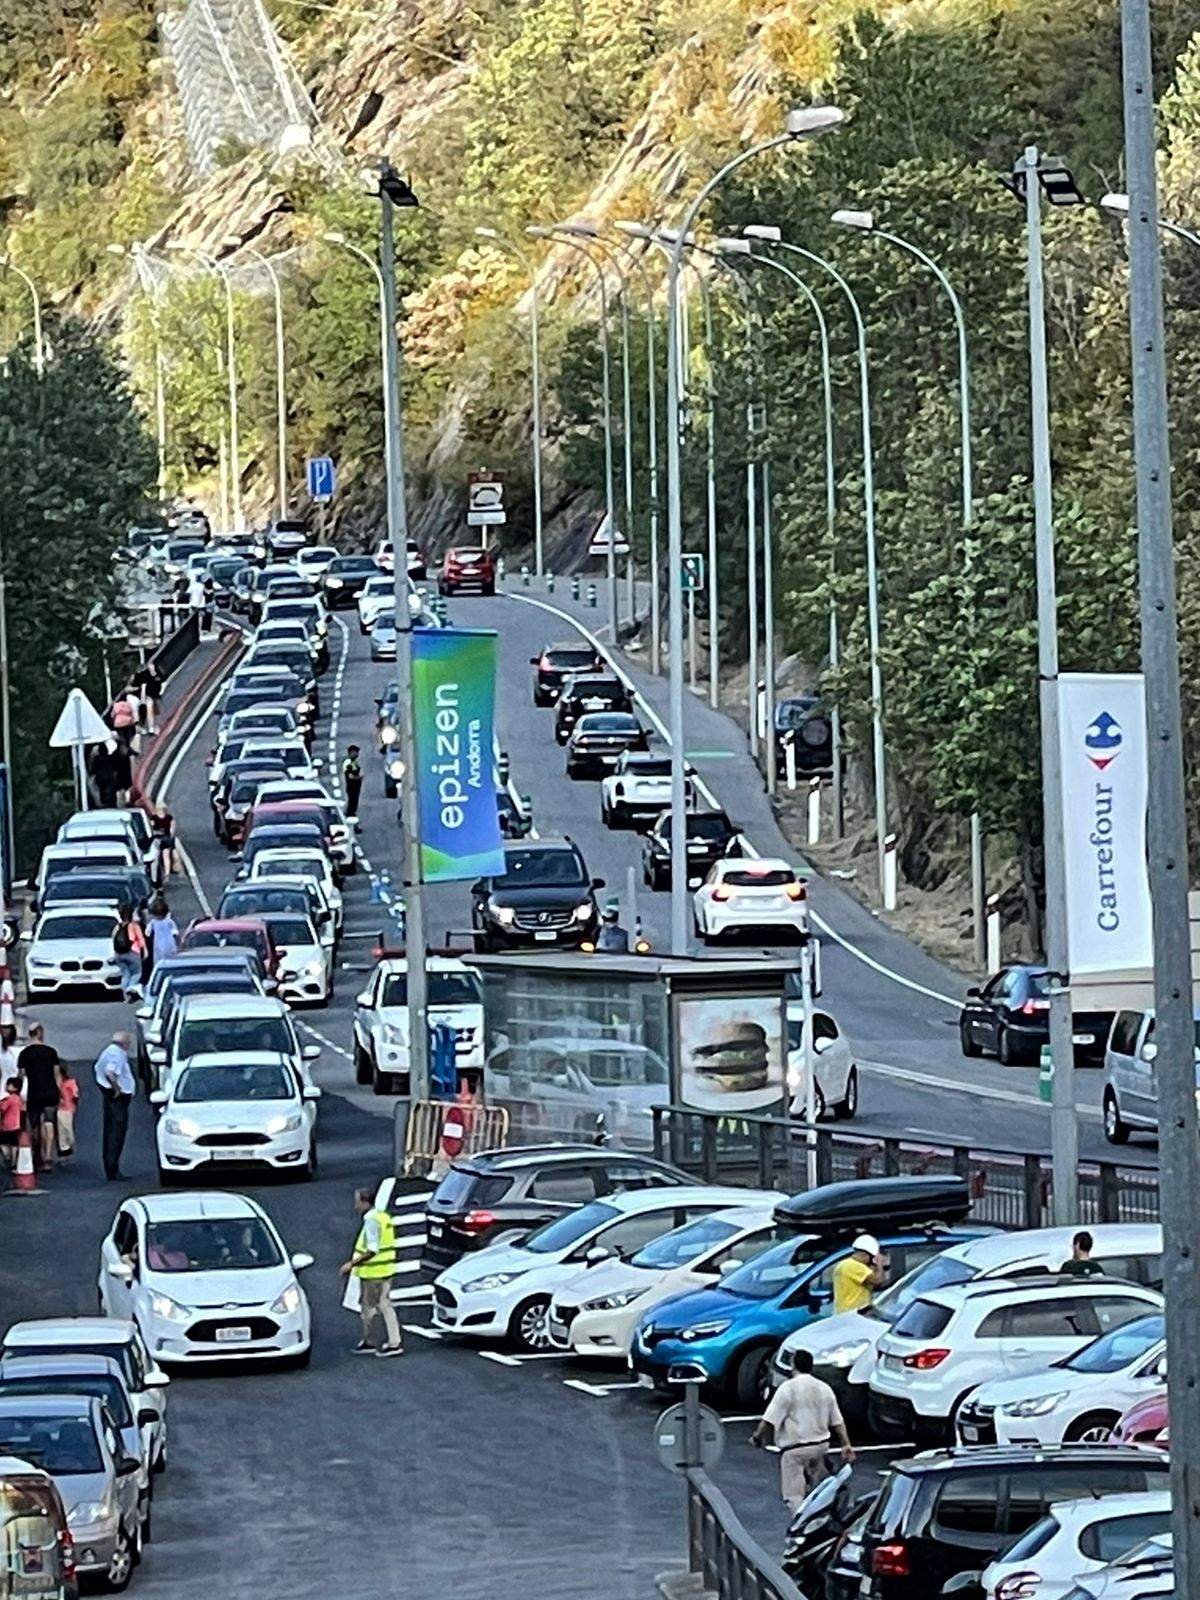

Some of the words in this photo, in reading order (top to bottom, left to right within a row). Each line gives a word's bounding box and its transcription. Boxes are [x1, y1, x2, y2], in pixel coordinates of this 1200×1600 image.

[431, 683, 469, 829] epizen
[467, 719, 482, 788] Andorra
[1089, 782, 1120, 932] Carrefour
